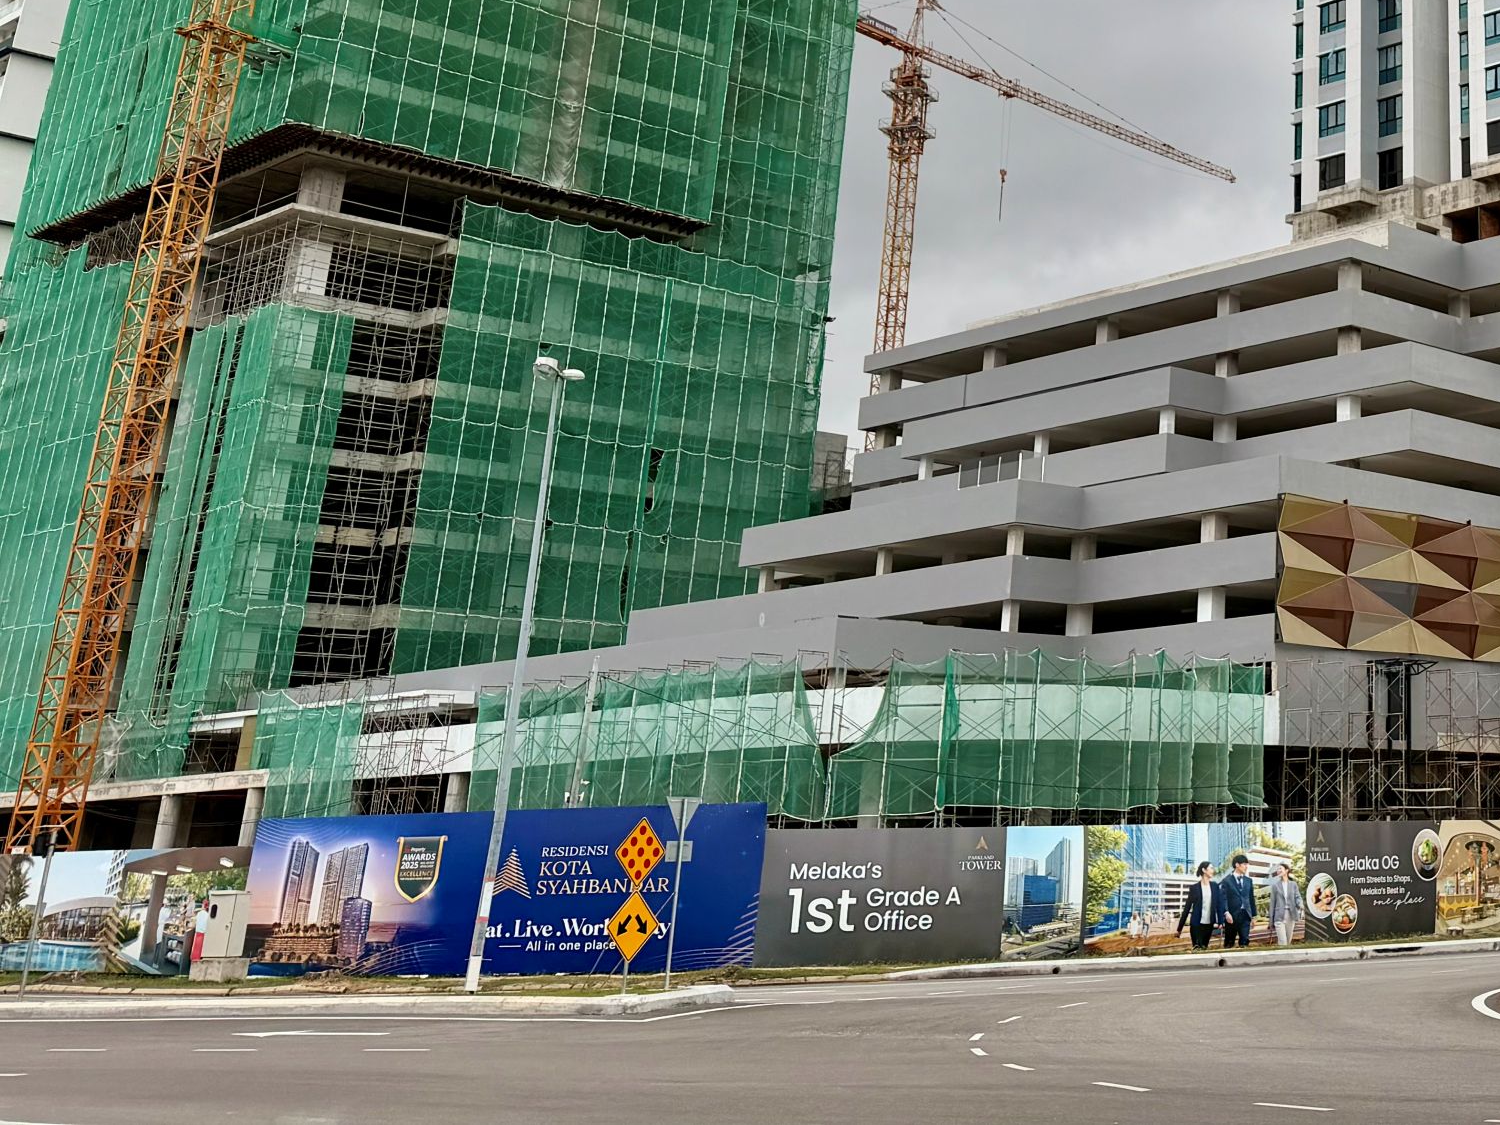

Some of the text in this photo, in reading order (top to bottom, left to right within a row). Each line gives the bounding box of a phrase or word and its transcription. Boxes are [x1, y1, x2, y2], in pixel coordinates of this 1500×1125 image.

[402, 853, 437, 861] AWARDS
[541, 845, 609, 858] RESIDENSI
[1309, 852, 1331, 862] MALL
[400, 861, 419, 869] 2025
[540, 860, 593, 876] KOTA
[789, 861, 883, 880] Melaka’s
[958, 860, 1002, 871] TOWER
[1337, 855, 1400, 872] Melaka OG
[1350, 876, 1366, 884] From
[1366, 875, 1386, 884] Streets
[1386, 875, 1393, 883] to
[866, 886, 961, 907] Grade A
[1386, 886, 1399, 895] Best
[1399, 885, 1405, 894] in
[1373, 891, 1425, 910] one place
[788, 887, 857, 934] 1st
[864, 910, 933, 932] Office
[485, 923, 503, 938] at
[525, 938, 617, 952] All in one place
